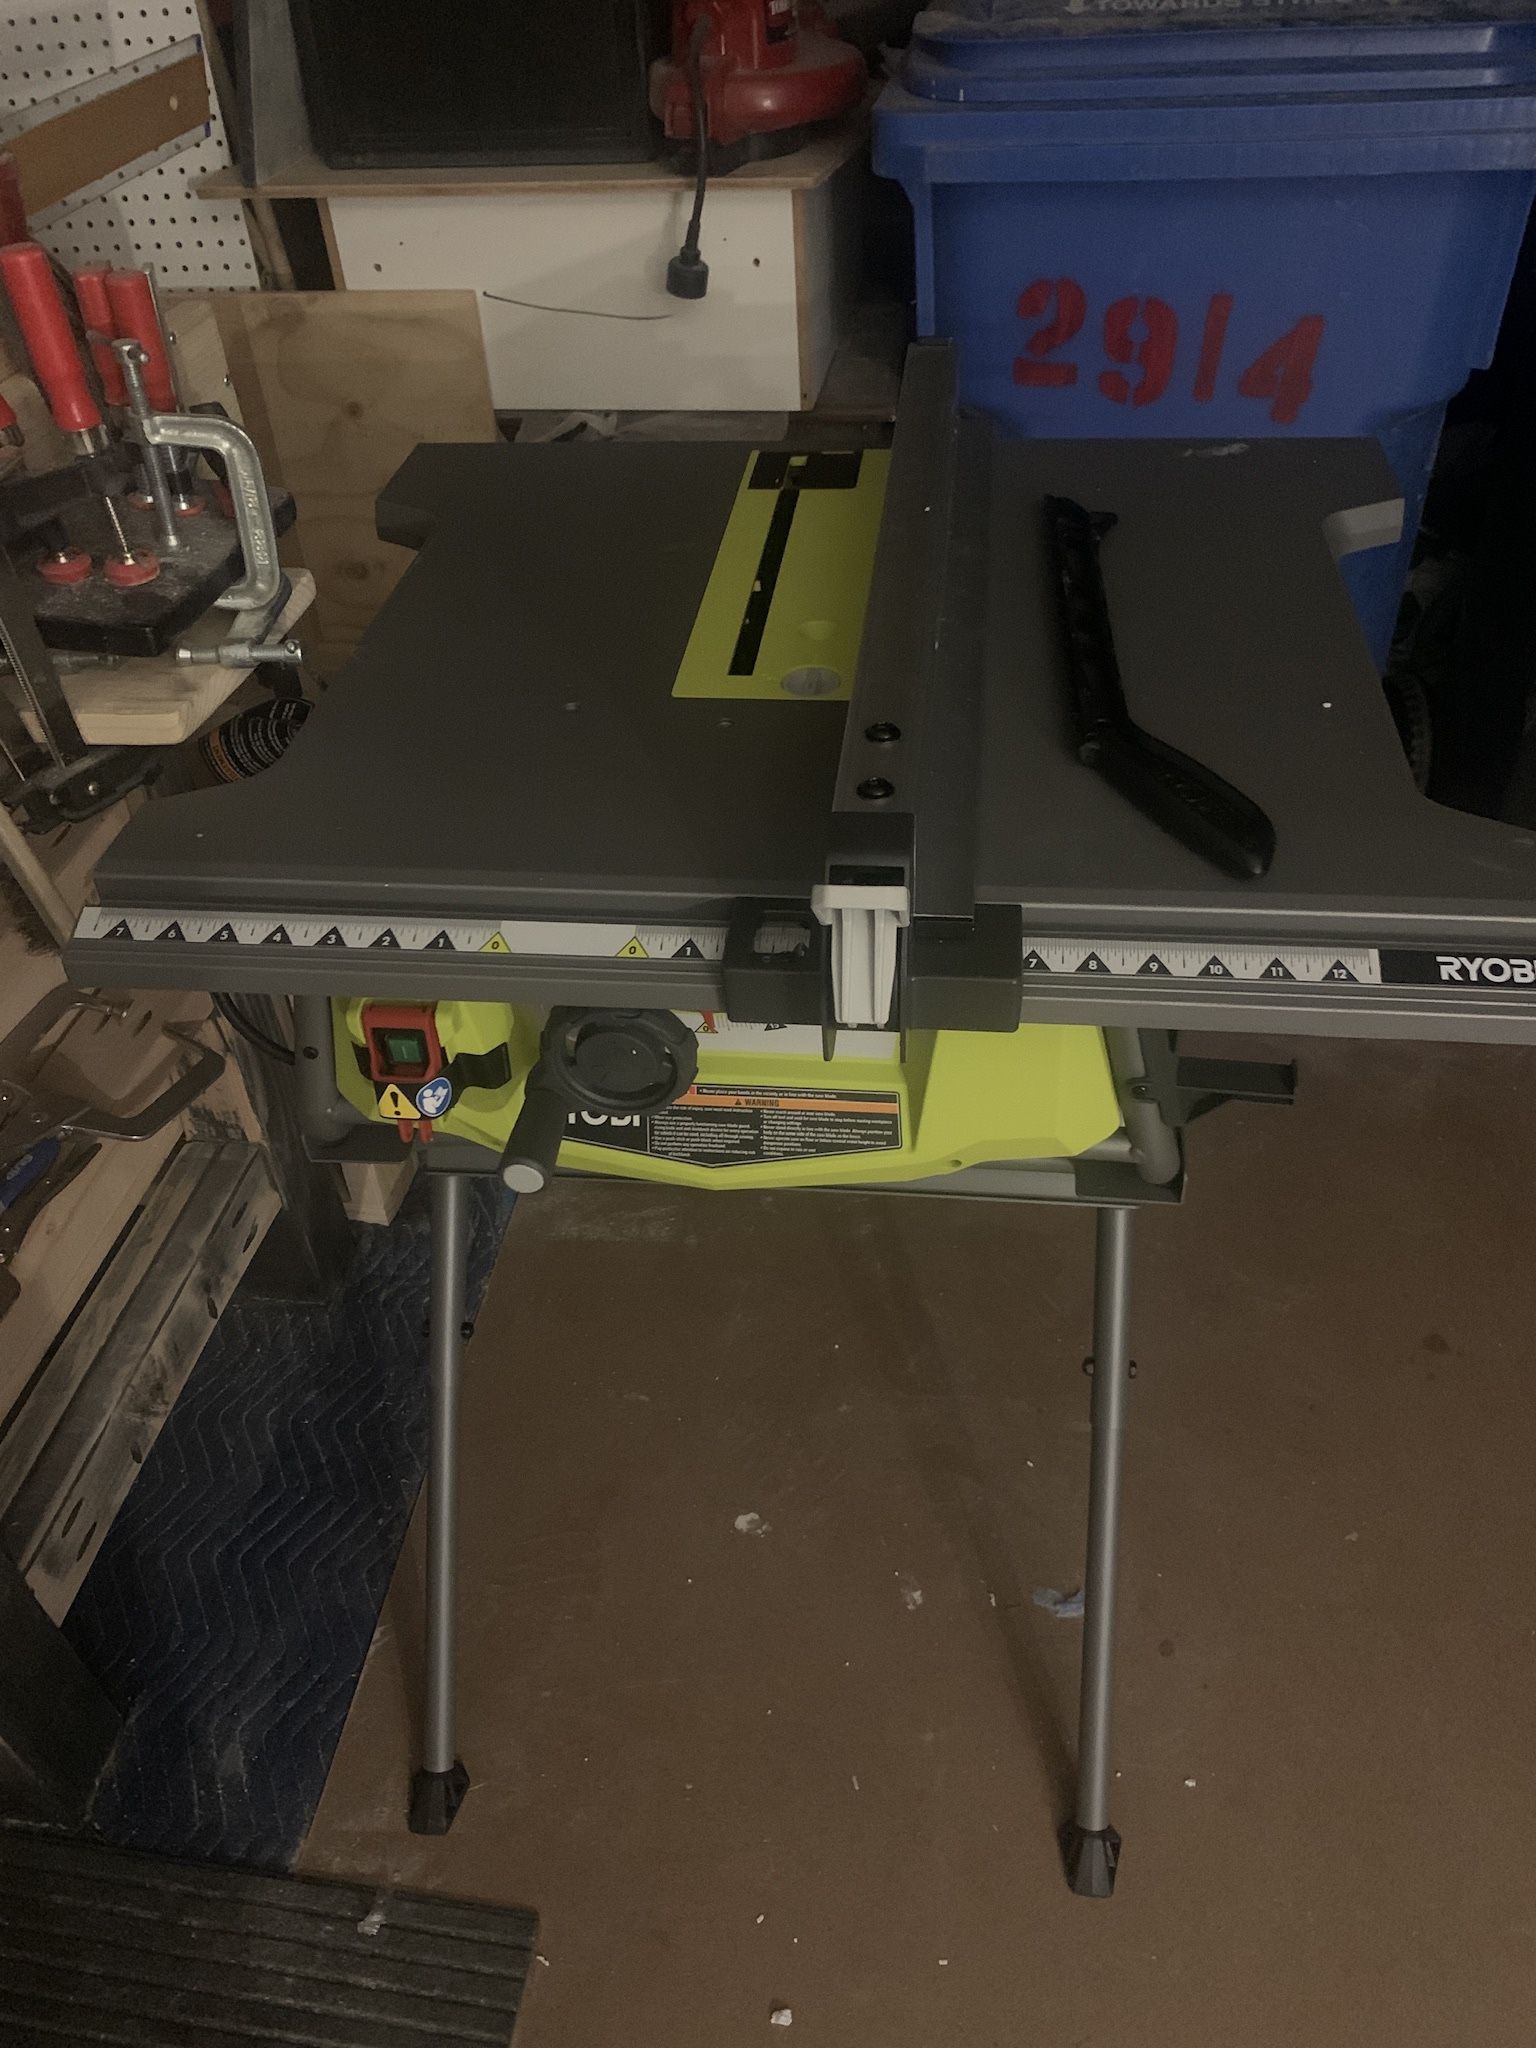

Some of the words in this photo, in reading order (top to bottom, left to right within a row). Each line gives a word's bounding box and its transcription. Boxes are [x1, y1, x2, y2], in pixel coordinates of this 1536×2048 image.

[1012, 276, 1325, 424] 2914
[115, 927, 125, 937] 7
[168, 929, 176, 939] 6
[219, 930, 229, 940] 5
[272, 932, 282, 943] 4
[327, 934, 337, 945] 3
[381, 936, 391, 946] 2
[438, 938, 445, 948] 1
[491, 941, 499, 950] 0
[629, 946, 637, 955] 0
[685, 946, 692, 956] 1
[1029, 958, 1038, 968] 7
[1088, 960, 1098, 970] 8
[1149, 962, 1159, 973] 9
[1209, 964, 1224, 975] 10
[1270, 966, 1284, 977] 11
[1332, 968, 1347, 979] 12
[1436, 956, 1536, 983] RYOB
[744, 1098, 780, 1107] WARNING
